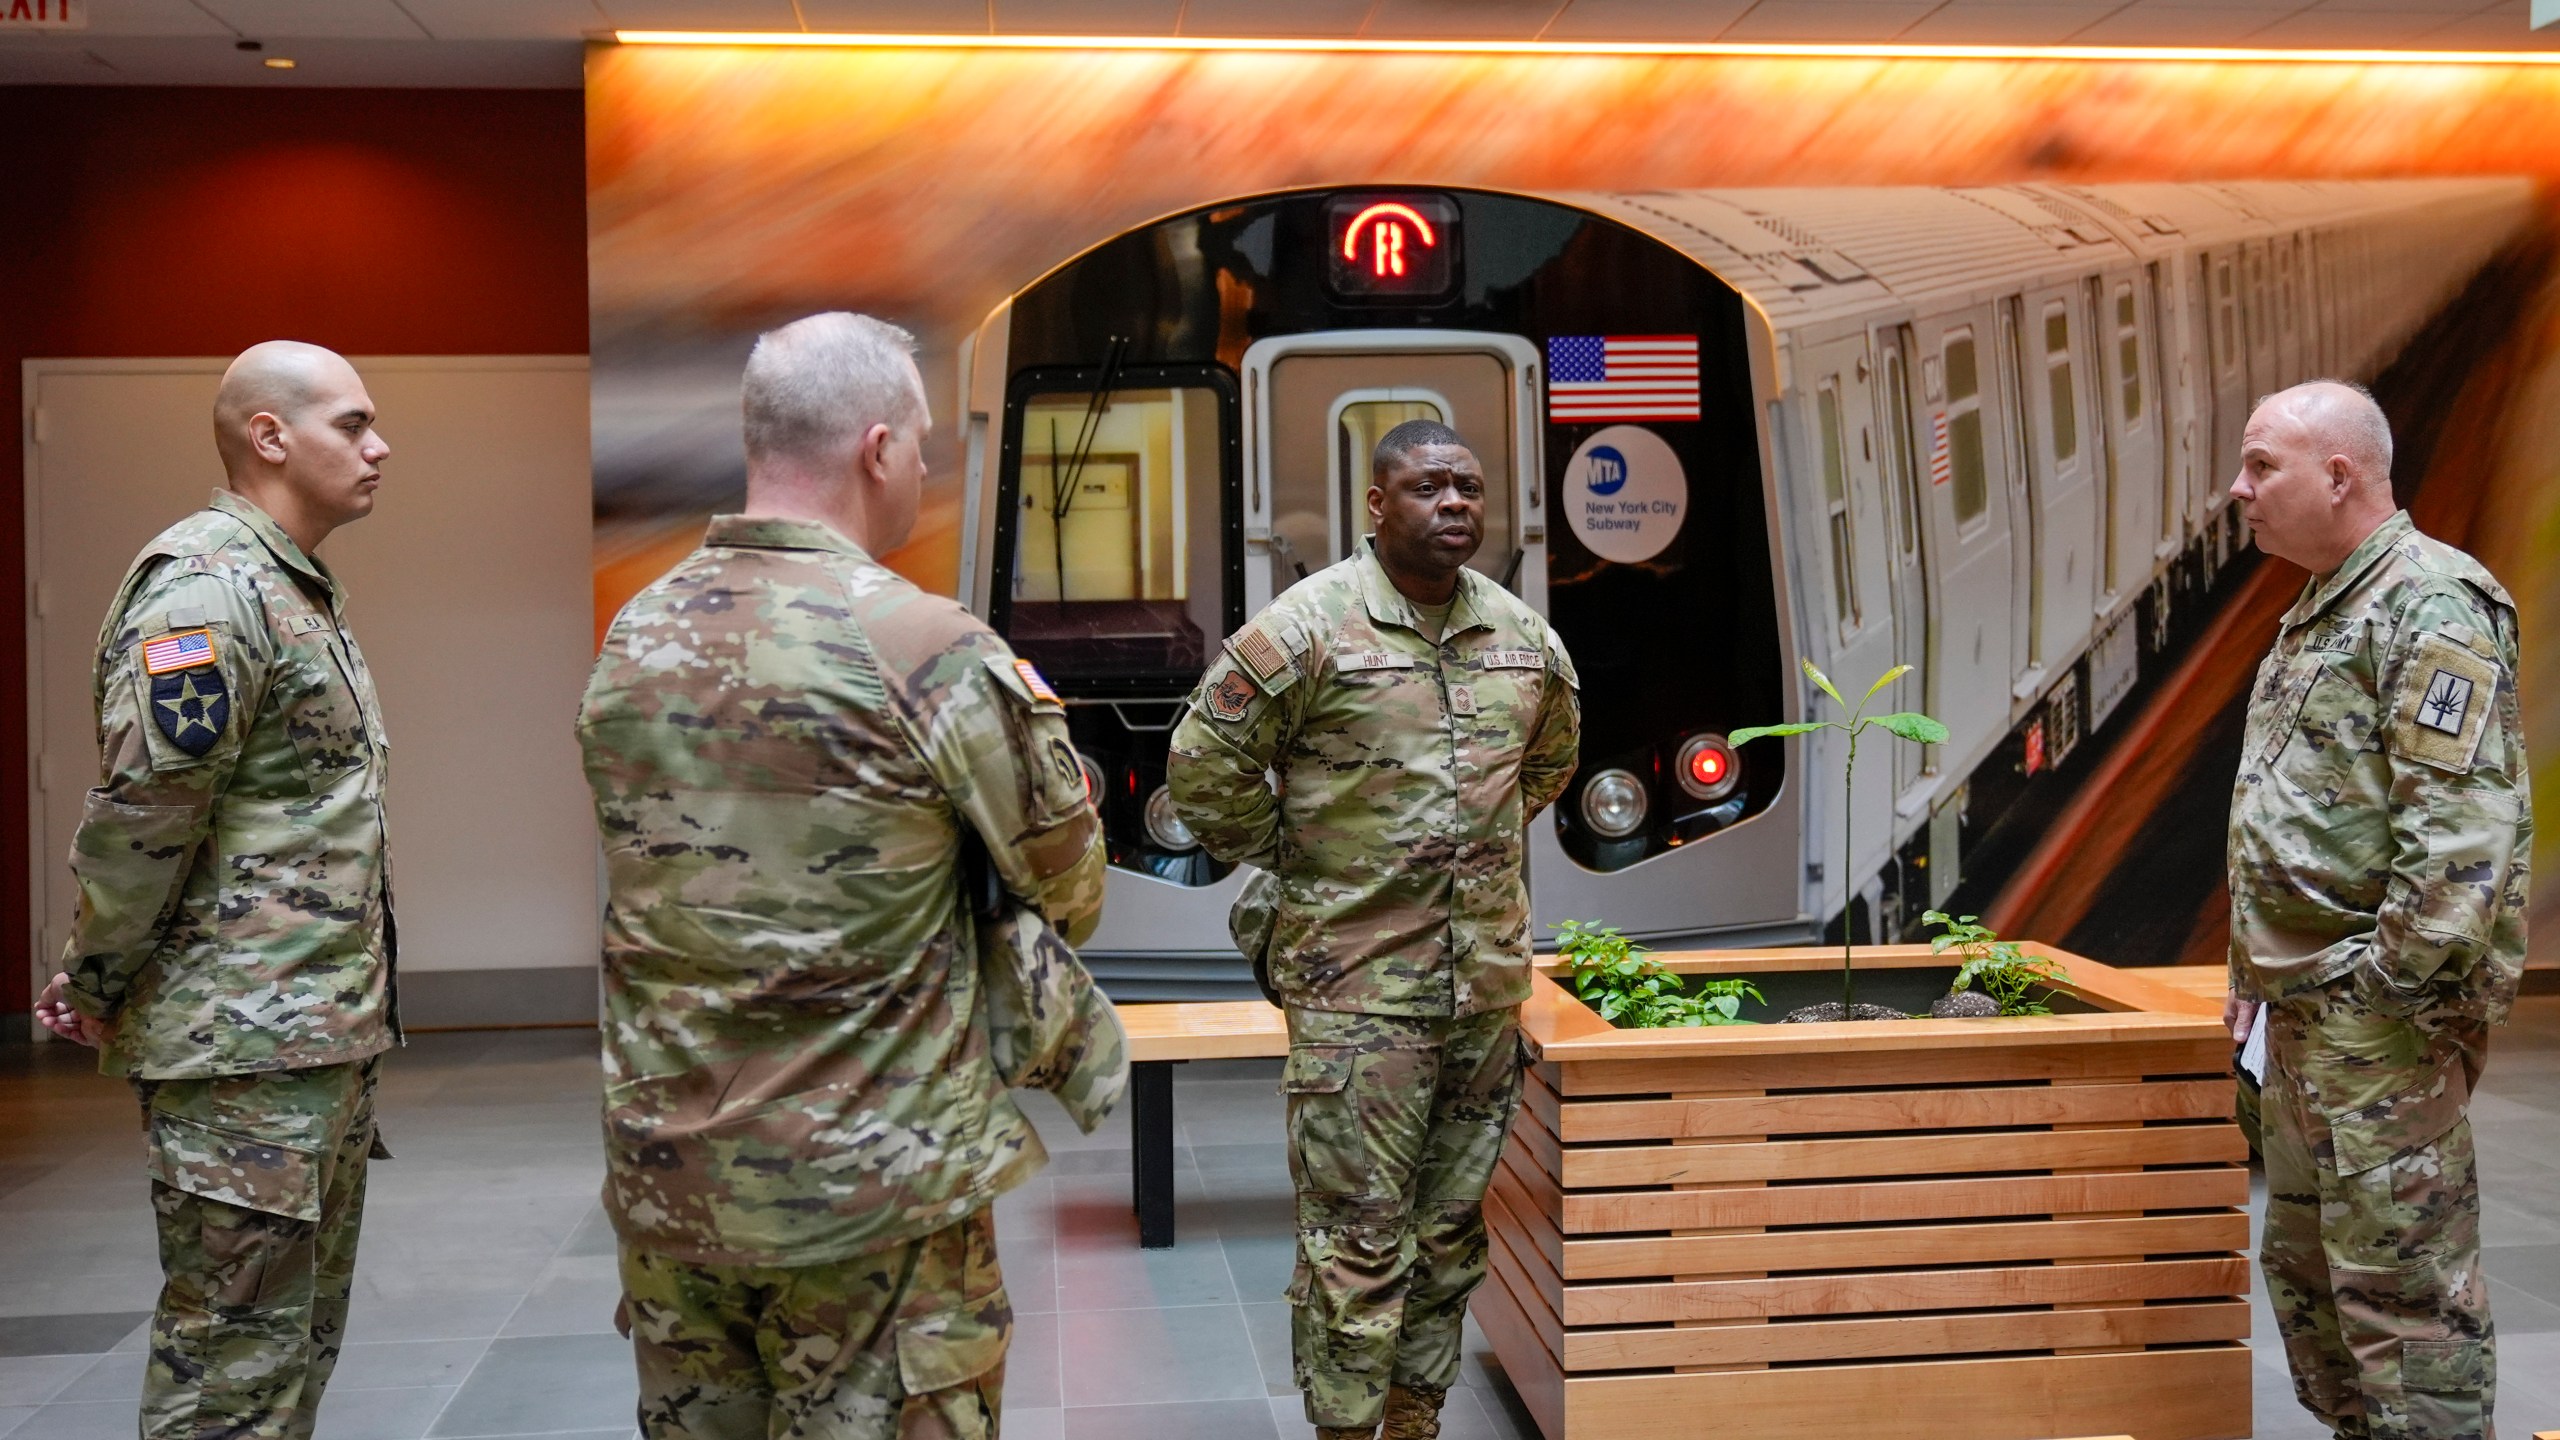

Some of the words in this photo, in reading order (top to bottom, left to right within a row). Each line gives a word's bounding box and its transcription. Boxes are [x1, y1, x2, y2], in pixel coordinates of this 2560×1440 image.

[1375, 221, 1404, 276] R
[1585, 457, 1621, 485] MTA
[1585, 502, 1614, 514] New
[1618, 501, 1648, 514] York
[1652, 501, 1677, 516] City
[1586, 518, 1640, 532] Subway
[1362, 654, 1388, 668] HUNT
[1486, 654, 1504, 666] U.S.
[1504, 653, 1519, 665] AIR
[1518, 653, 1541, 667] FORCE
